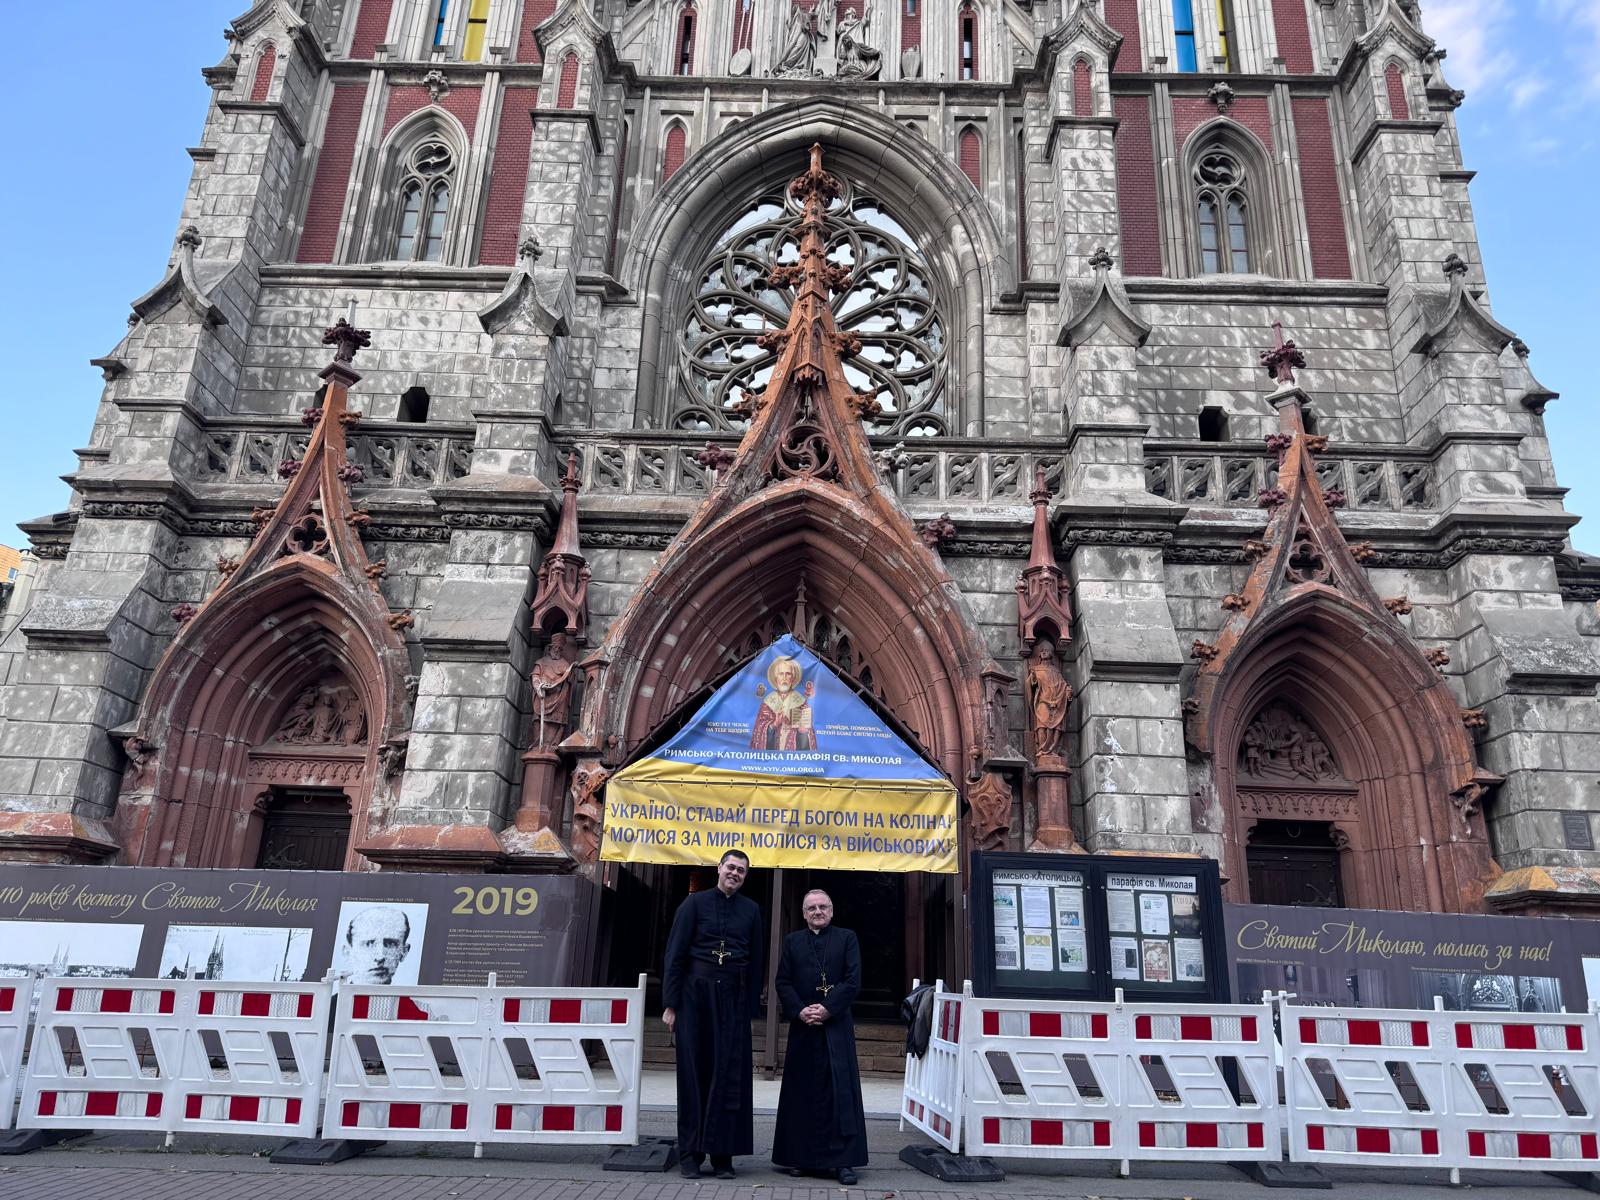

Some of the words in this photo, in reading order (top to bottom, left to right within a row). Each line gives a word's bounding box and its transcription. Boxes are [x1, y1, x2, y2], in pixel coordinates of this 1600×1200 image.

[664, 748, 783, 761] РИМСЬКО-КАТОЛИЦЬКА
[786, 752, 830, 761] ПАРАФІЯ
[833, 754, 849, 762] СВ.
[851, 755, 901, 765] МИКОЛАЯ
[611, 800, 680, 821] УКРАЇНО!
[685, 802, 746, 823] СТАВАЙ
[751, 807, 800, 827] ПЕРЕД
[804, 809, 858, 827] БОГОМ
[863, 811, 885, 828] НА
[889, 812, 952, 830] КОЛІНА!
[610, 826, 676, 845] МОЛИСЯ
[681, 829, 702, 847] ЗА
[706, 831, 745, 848] МИР!
[750, 831, 817, 850] МОЛИСЯ
[821, 833, 842, 851] ЗА
[847, 831, 952, 854] ВІЙСЬКОВИХ!
[993, 872, 1082, 883] РИМСЬКО-КАТОЛИЦЬКА
[1111, 876, 1143, 889] парафія
[1145, 880, 1157, 888] св.
[1158, 877, 1193, 889] Миколая
[18, 883, 76, 917] років
[72, 883, 137, 919] костелу
[141, 881, 222, 911] Святого
[219, 880, 319, 916] Миколая
[451, 886, 539, 916] 2019
[1236, 919, 1321, 951] Святий
[1319, 921, 1426, 959] Миколаю,
[1432, 941, 1489, 959] молись
[1484, 944, 1513, 971] за
[1519, 940, 1553, 962] нас!
